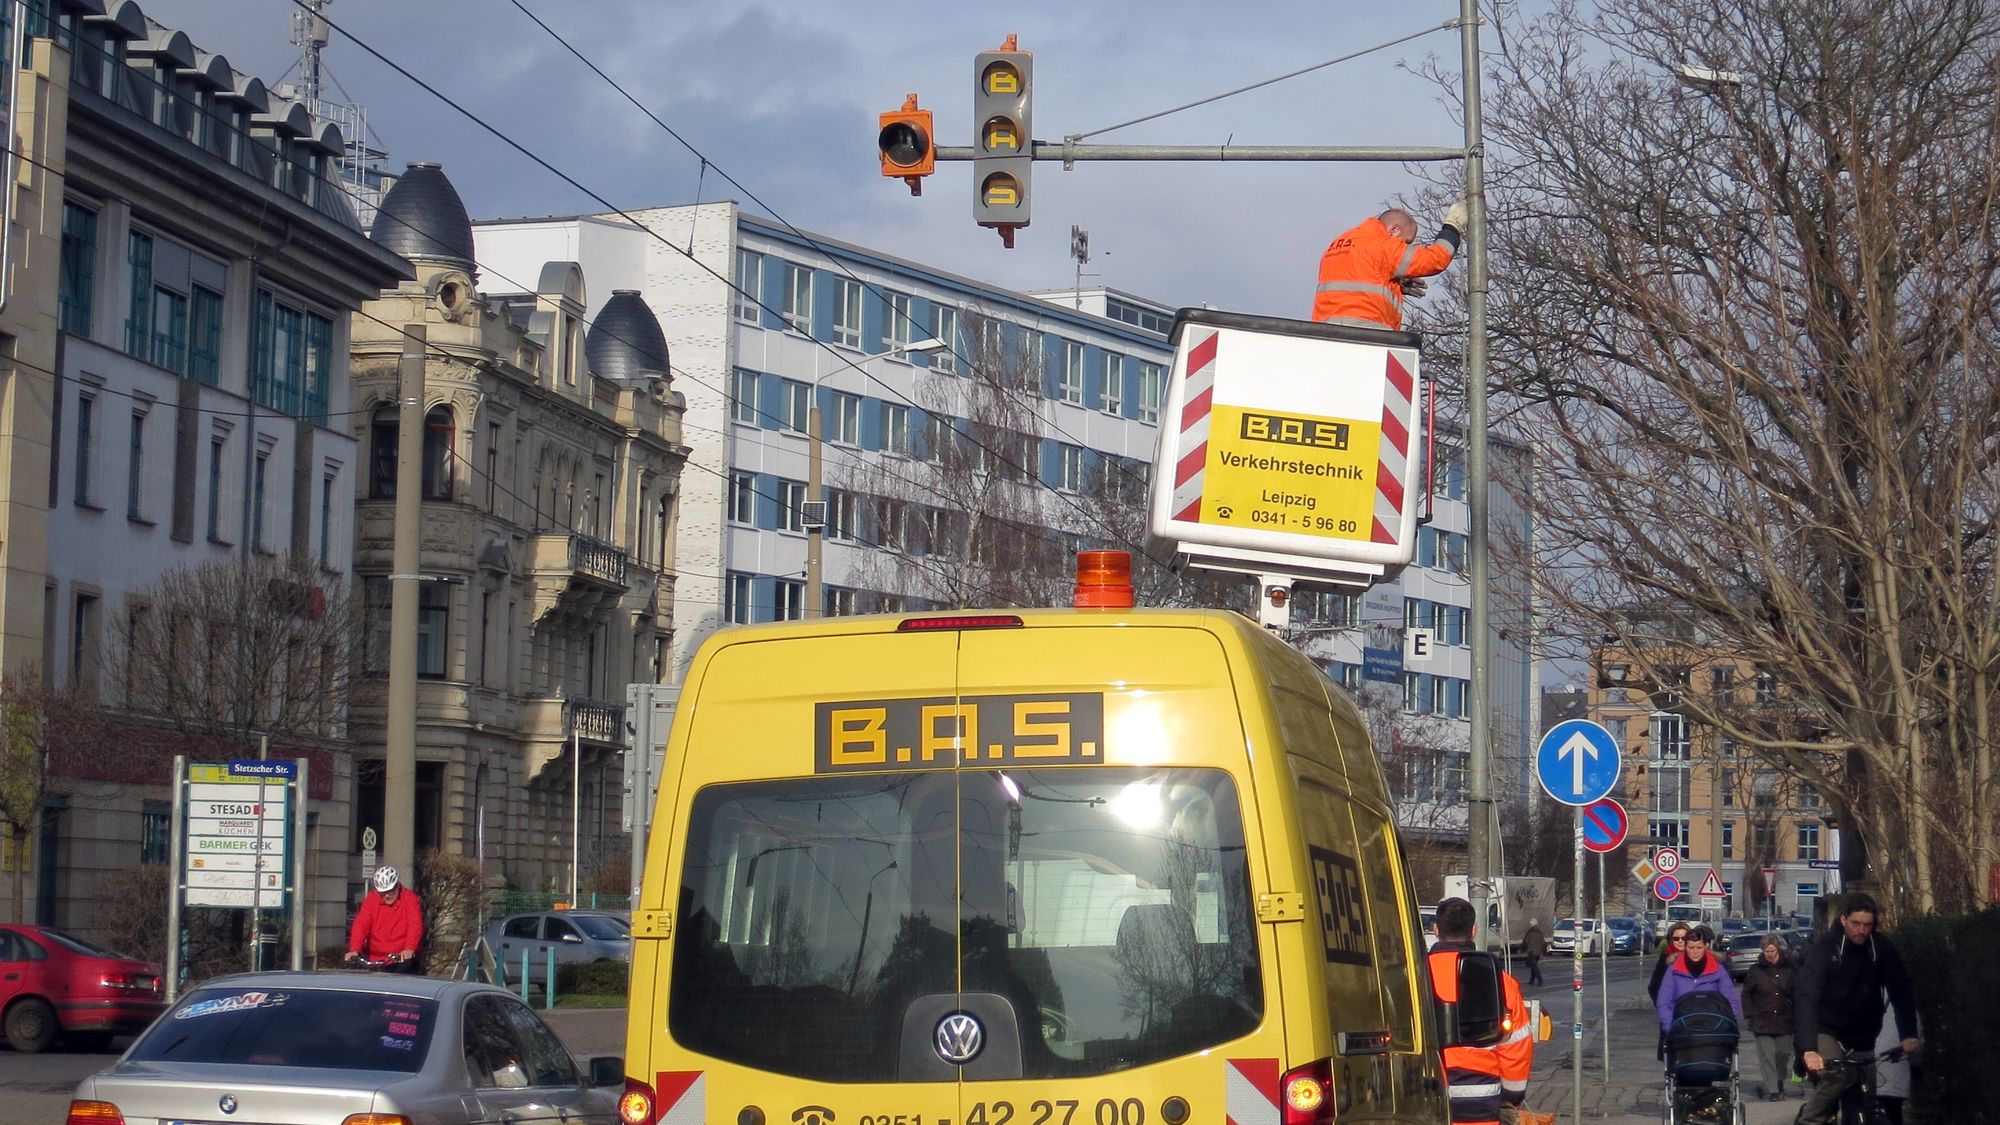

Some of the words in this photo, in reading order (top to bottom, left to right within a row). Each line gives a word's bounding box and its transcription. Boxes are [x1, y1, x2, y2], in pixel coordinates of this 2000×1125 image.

[1246, 416, 1346, 448] B.A.S.
[1219, 450, 1364, 481] Verkehrstechnik
[1262, 489, 1317, 510] Leipzig
[1251, 509, 1287, 525] 0341
[1302, 515, 1311, 528] 5
[1315, 516, 1334, 531] 96
[1338, 518, 1357, 533] 80
[1414, 634, 1427, 656] E
[830, 702, 1096, 765] B.A.S.
[234, 763, 273, 774] Stetzscher
[275, 766, 289, 774] Str.
[210, 804, 251, 815] STESAD
[199, 839, 248, 850] BARMER
[1660, 855, 1675, 868] 30
[965, 1101, 1015, 1125] 42
[1030, 1099, 1079, 1125] 27
[1094, 1097, 1145, 1125] 00
